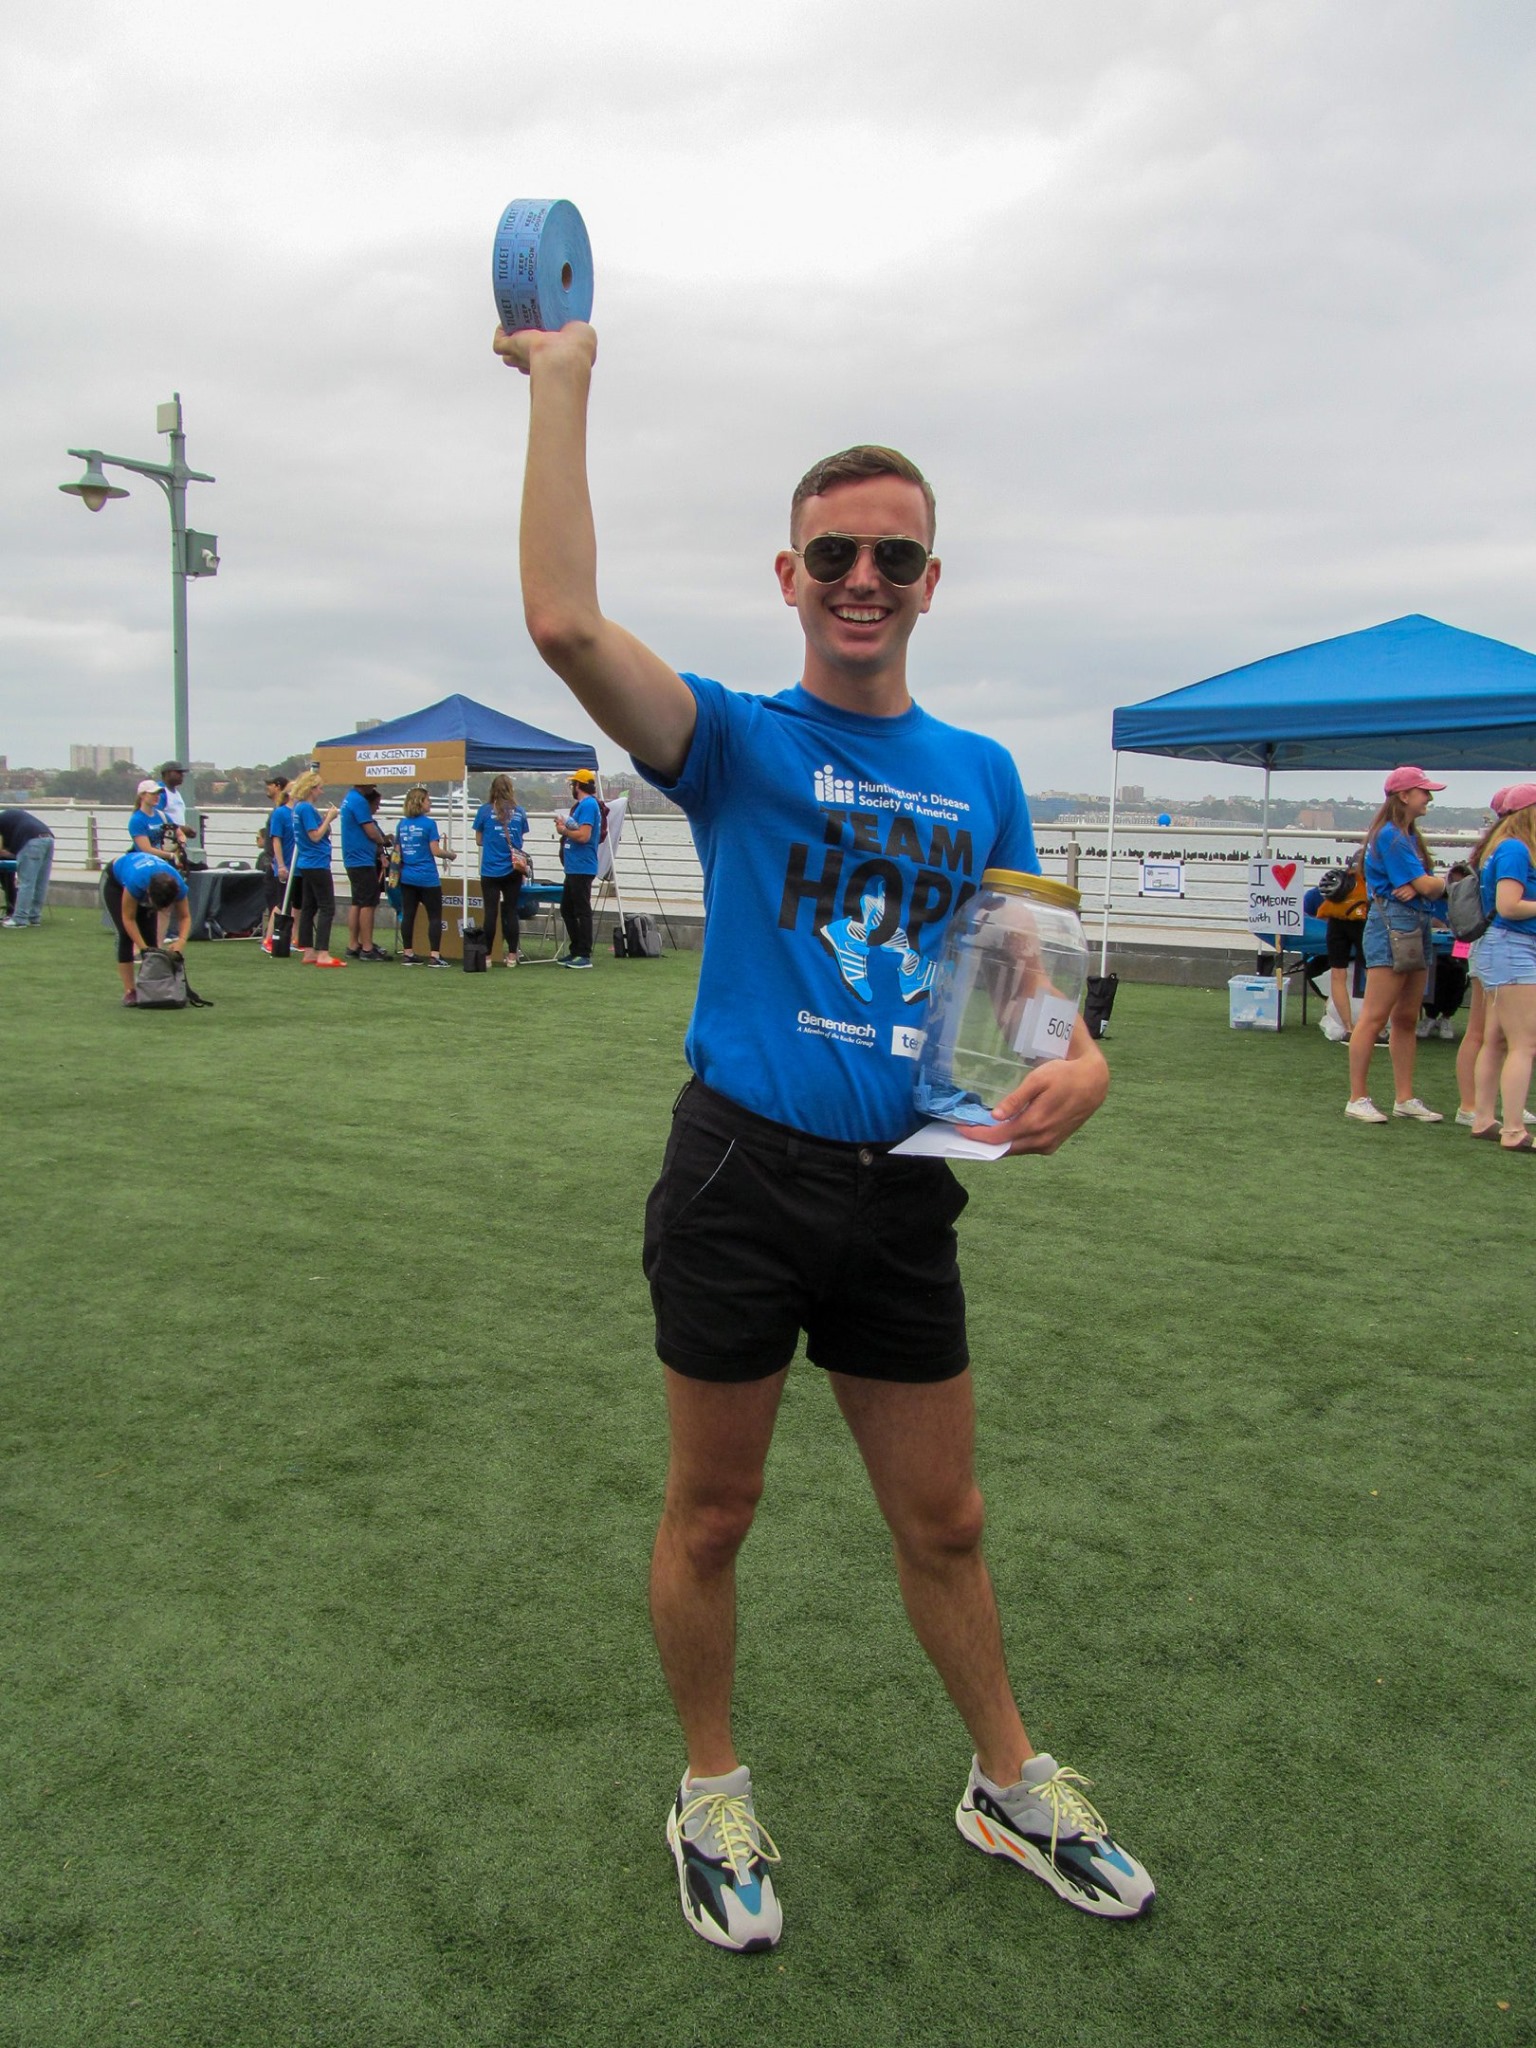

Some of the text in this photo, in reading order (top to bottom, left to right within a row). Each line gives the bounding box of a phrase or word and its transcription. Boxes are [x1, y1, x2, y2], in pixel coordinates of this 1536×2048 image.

[499, 248, 509, 280] TICKET
[358, 751, 371, 760] ASK
[381, 750, 425, 759] SCIENTIST
[367, 766, 412, 775] ANYTHING!
[858, 780, 970, 811] Huntington's Disease
[858, 796, 959, 822] Society of America
[820, 805, 974, 877] TEAM
[1250, 864, 1269, 886] I
[441, 896, 483, 907] SCIENIST
[1249, 892, 1298, 908] SOMEONE
[1249, 909, 1301, 927] with HD.
[797, 1010, 876, 1038] Genentech
